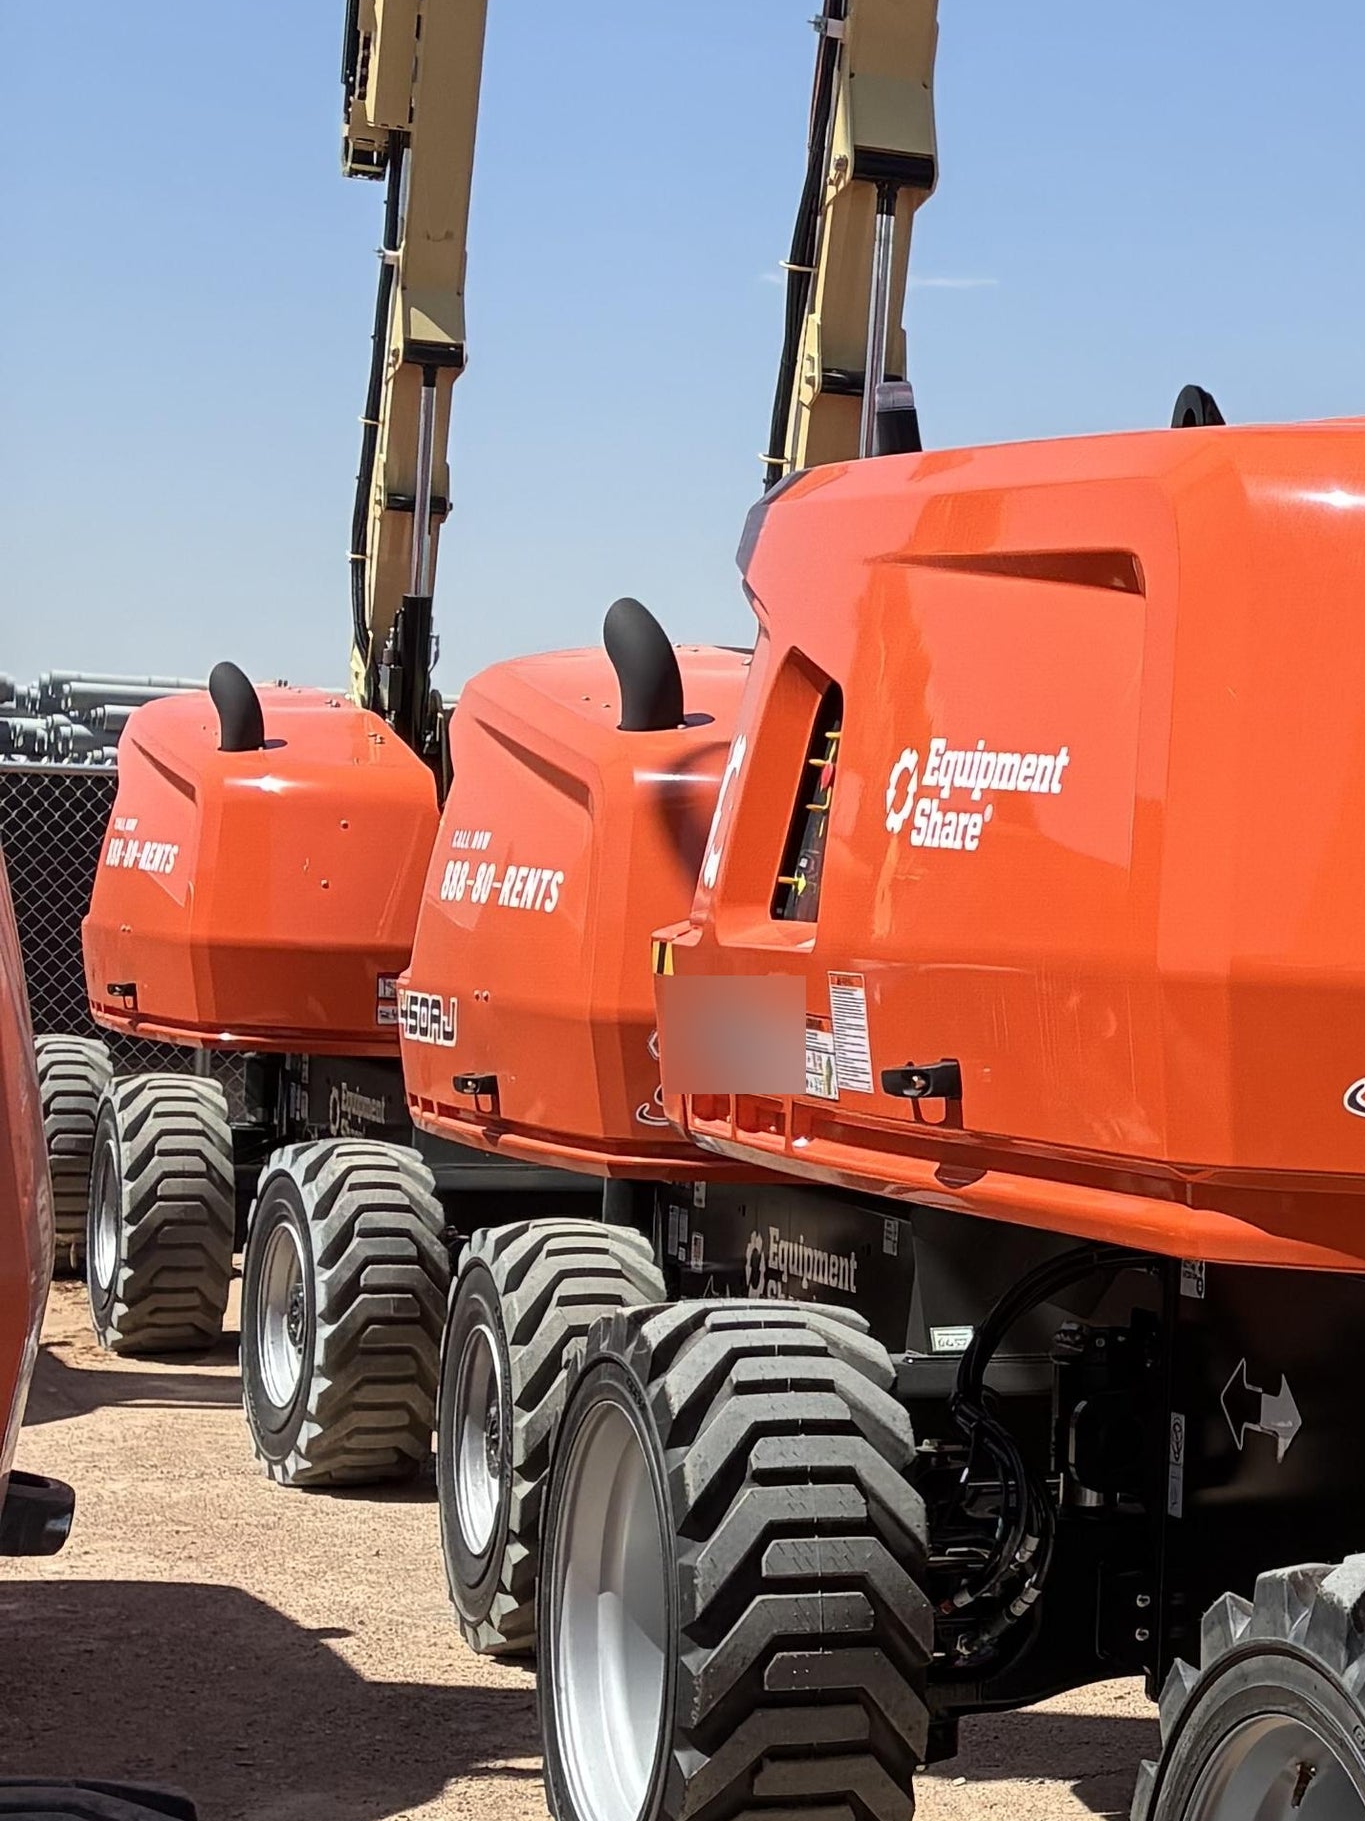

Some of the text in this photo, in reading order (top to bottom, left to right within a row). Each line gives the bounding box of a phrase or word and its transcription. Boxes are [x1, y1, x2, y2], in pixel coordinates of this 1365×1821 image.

[921, 737, 1070, 801] Equipment
[910, 797, 983, 851] Share
[440, 860, 564, 913] 888-80-RENTS
[768, 1227, 857, 1293] Equipment
